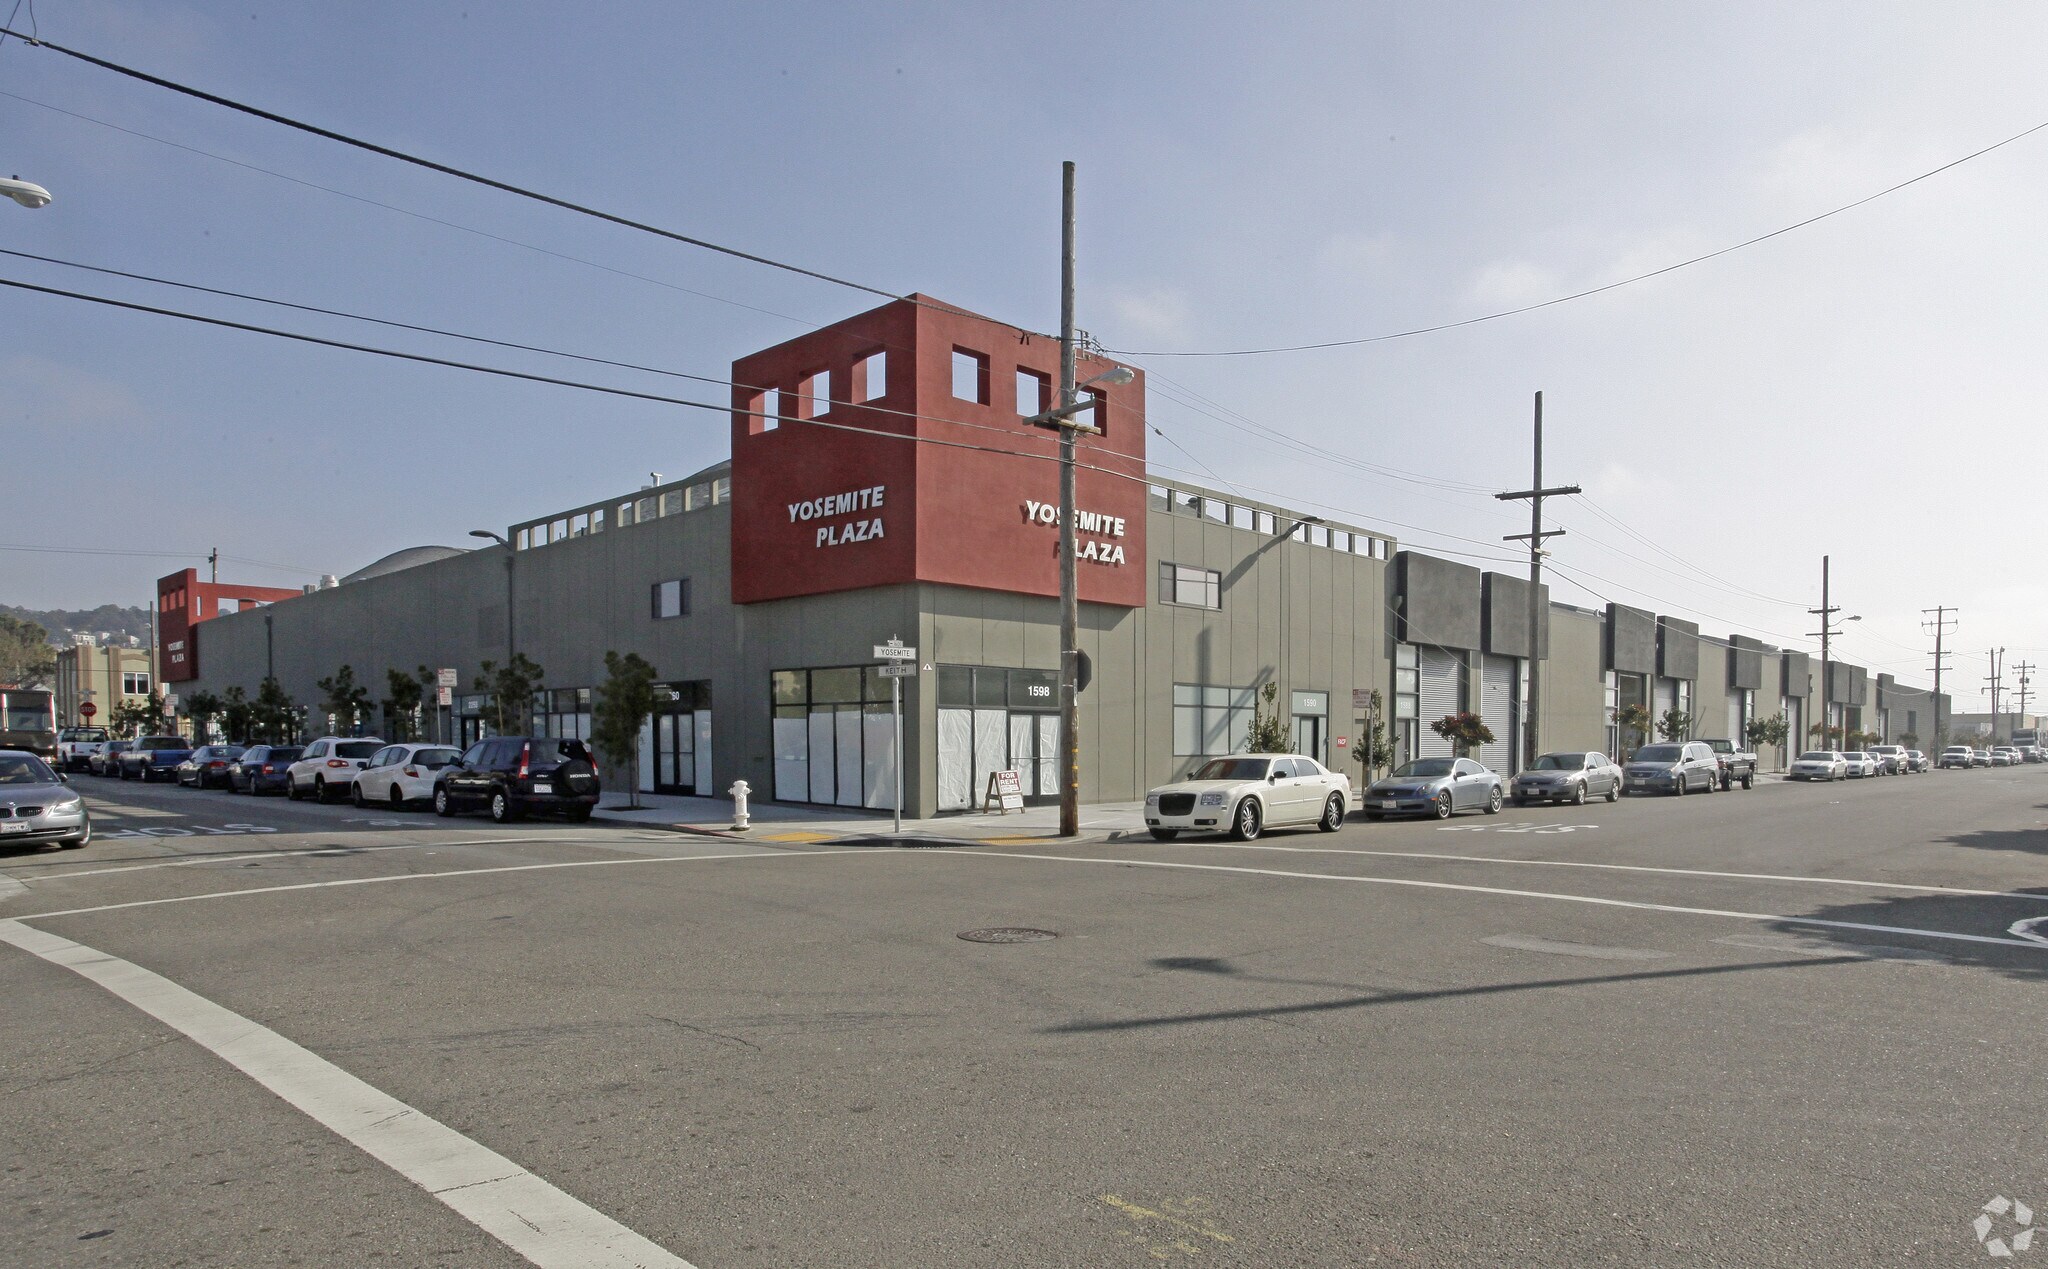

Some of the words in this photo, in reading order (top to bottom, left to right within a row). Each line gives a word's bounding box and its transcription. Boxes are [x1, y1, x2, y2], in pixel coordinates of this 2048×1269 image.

[788, 485, 885, 523] YOSEMITE
[816, 518, 884, 548] PLAZA
[1073, 538, 1125, 565] LAZA
[881, 648, 910, 657] YOSEMITE
[171, 653, 185, 664] PLAZA
[886, 666, 907, 675] KEITH
[1028, 685, 1050, 697] 1598
[1303, 698, 1317, 707] 1590
